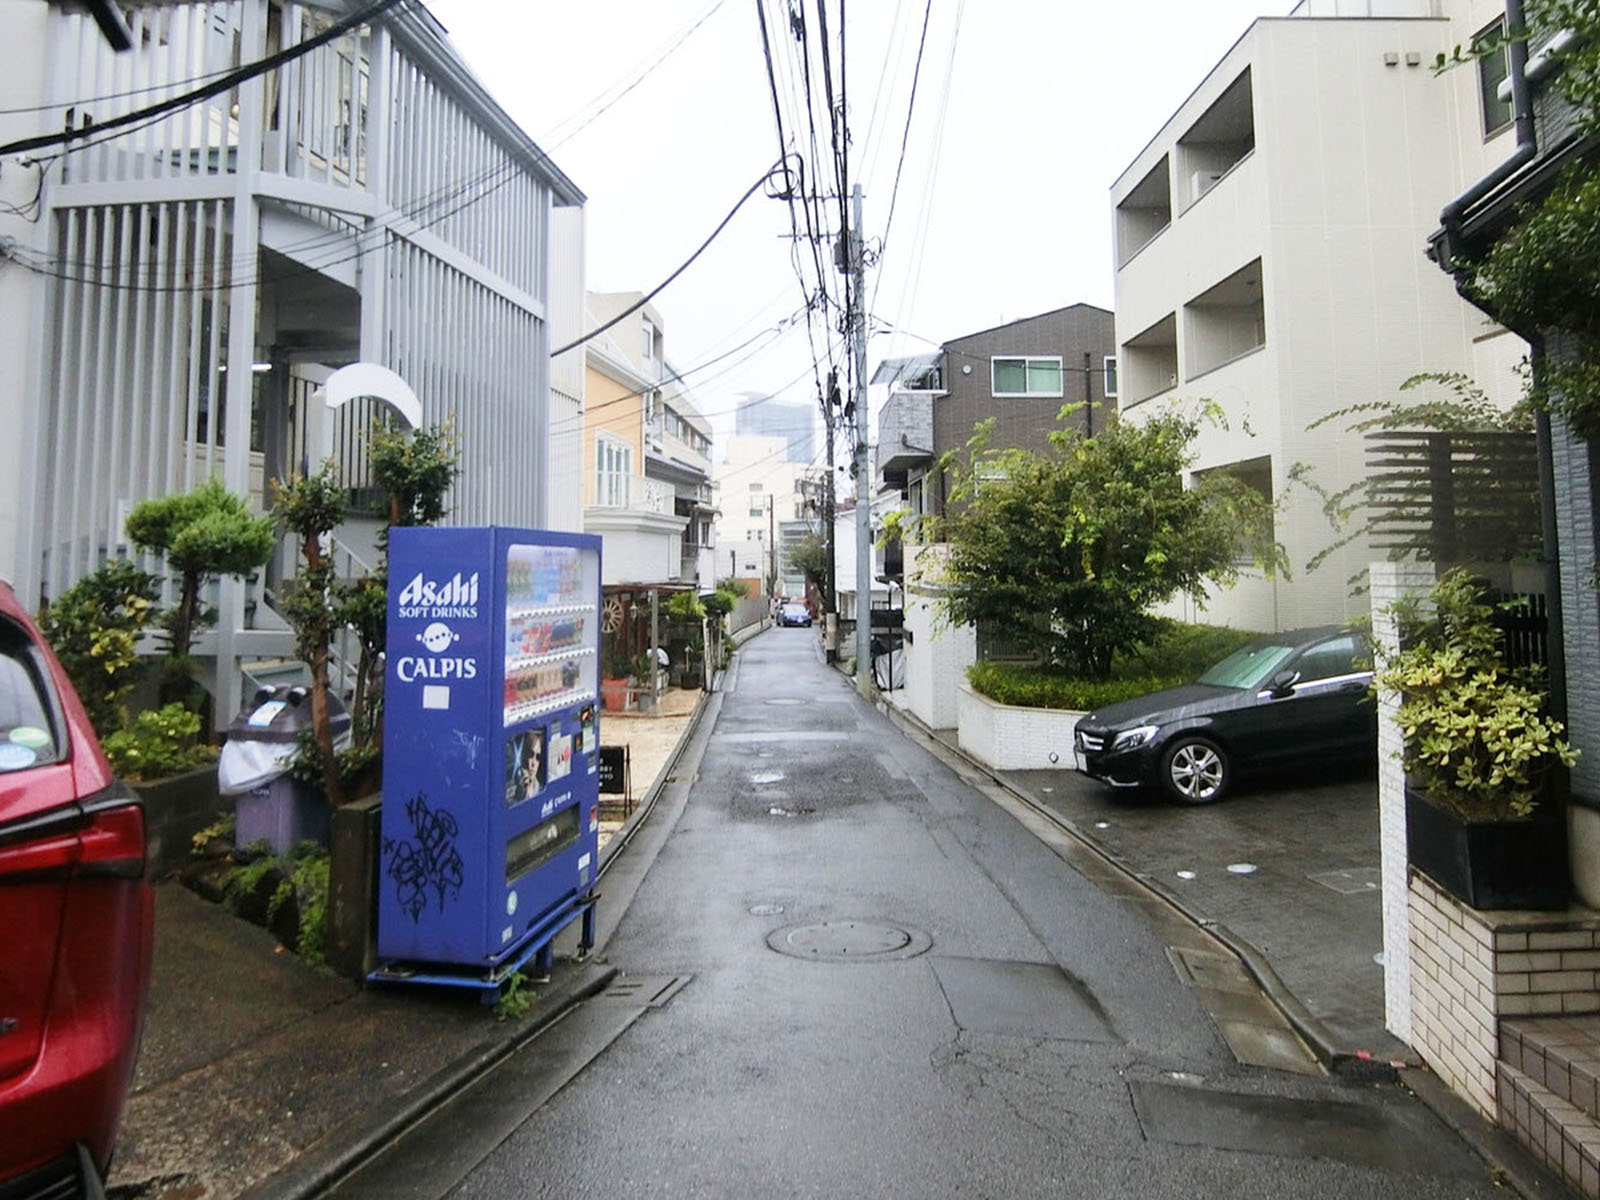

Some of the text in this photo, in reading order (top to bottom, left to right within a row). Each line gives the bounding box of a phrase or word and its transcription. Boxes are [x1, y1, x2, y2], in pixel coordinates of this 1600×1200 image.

[399, 572, 478, 606] Asahi
[399, 606, 478, 618] SOFT DRINKS
[397, 656, 477, 682] CALPIS
